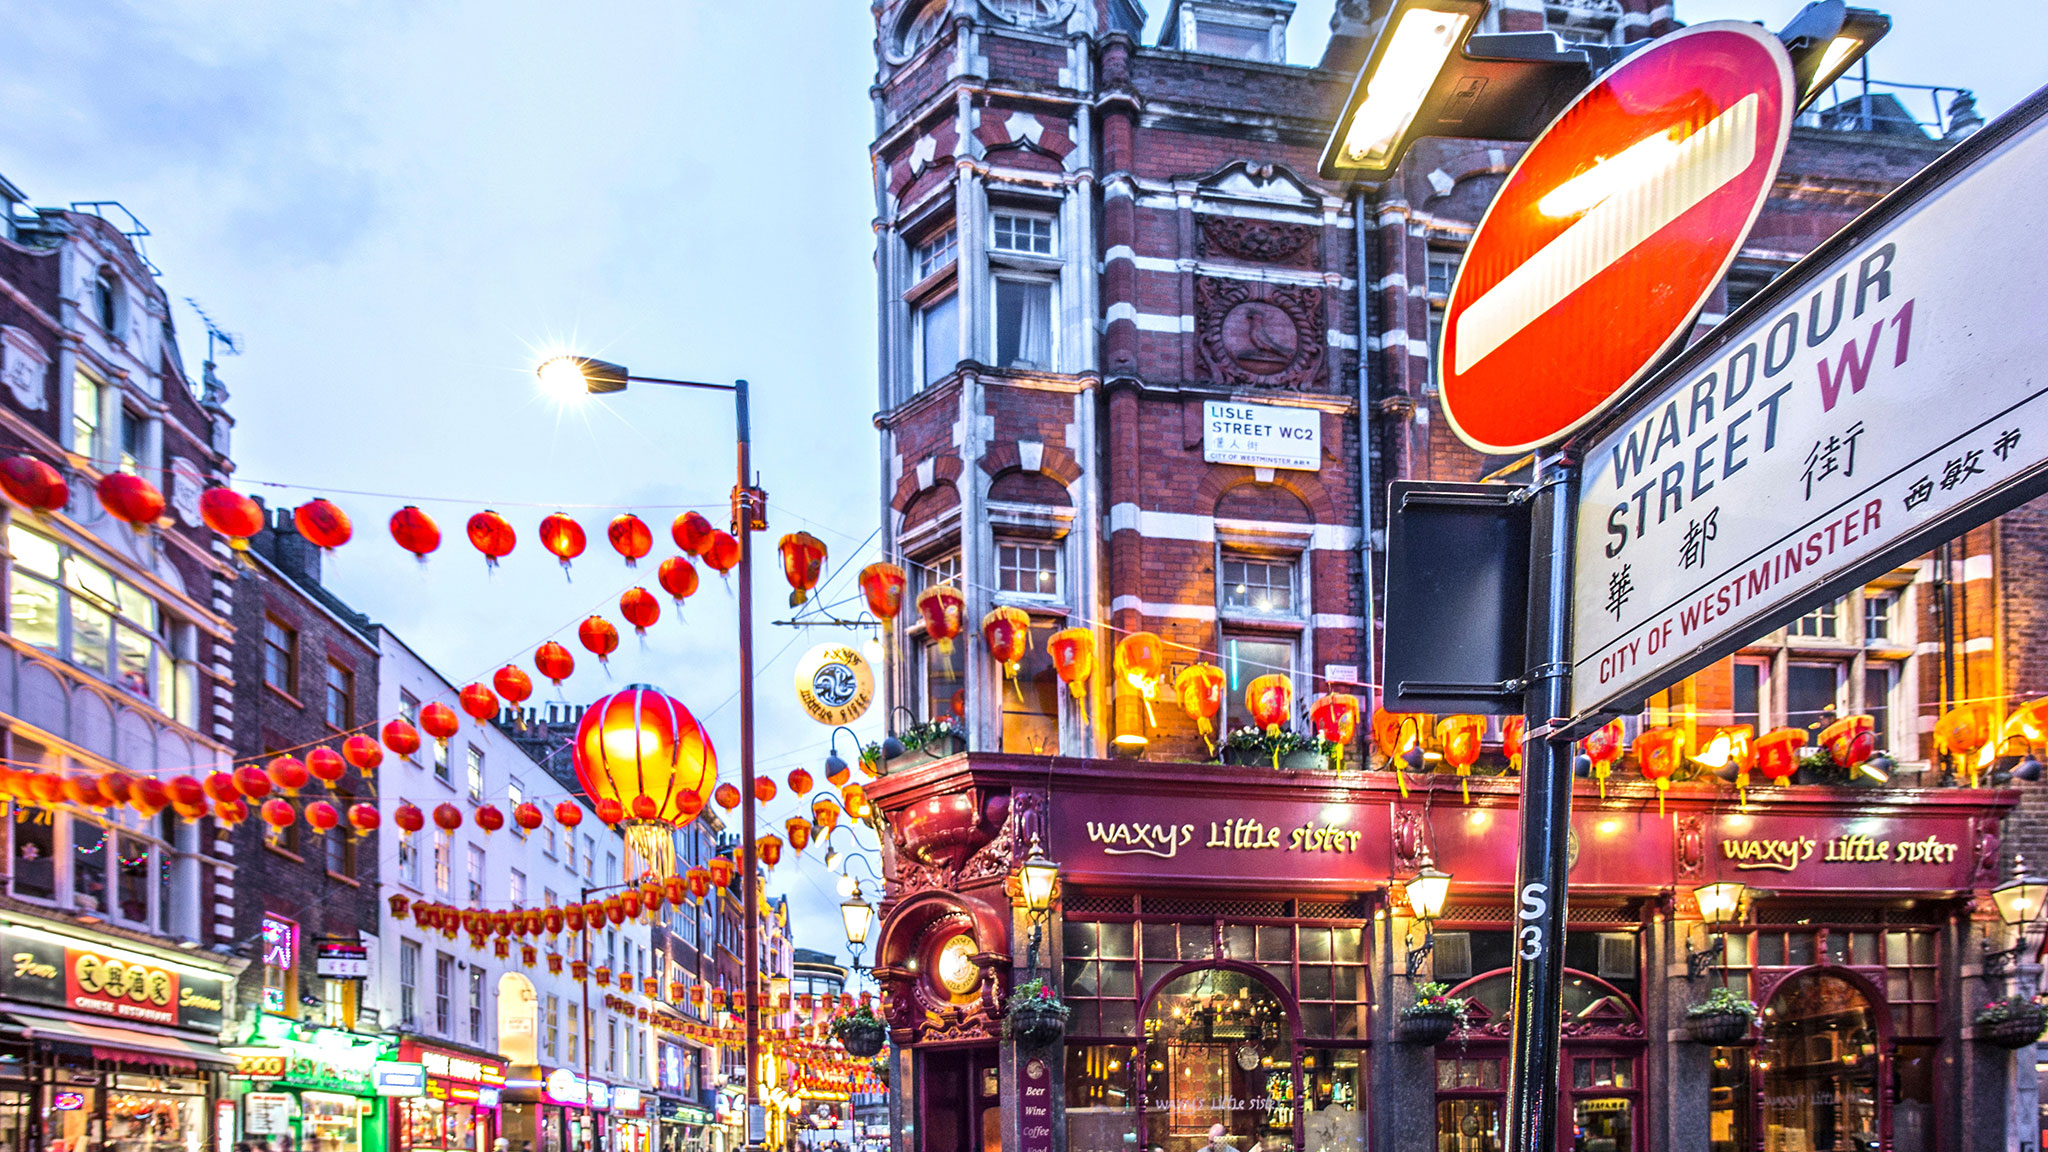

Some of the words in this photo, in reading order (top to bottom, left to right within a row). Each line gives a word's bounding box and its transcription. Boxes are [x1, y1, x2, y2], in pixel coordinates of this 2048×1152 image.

[1612, 242, 1896, 490] WARDOUR
[1211, 406, 1253, 420] LISLE
[1212, 421, 1272, 437] STREET
[1279, 426, 1313, 441] WC2
[1606, 382, 1793, 560] STREET
[1817, 298, 1916, 413] W1
[1210, 452, 1227, 460] CITY
[1240, 455, 1291, 465] WESTMINSTER
[1599, 637, 1642, 685] CITY
[1648, 618, 1673, 657] OF
[1680, 498, 1884, 636] WESTMINSTER
[1206, 818, 1281, 850] Little
[1289, 820, 1363, 852] sister
[1824, 834, 1890, 862] Little
[1895, 834, 1959, 863] sister
[1025, 1086, 1046, 1096] Beer
[1025, 1106, 1047, 1116] Wine
[1023, 1126, 1050, 1139] Coffee
